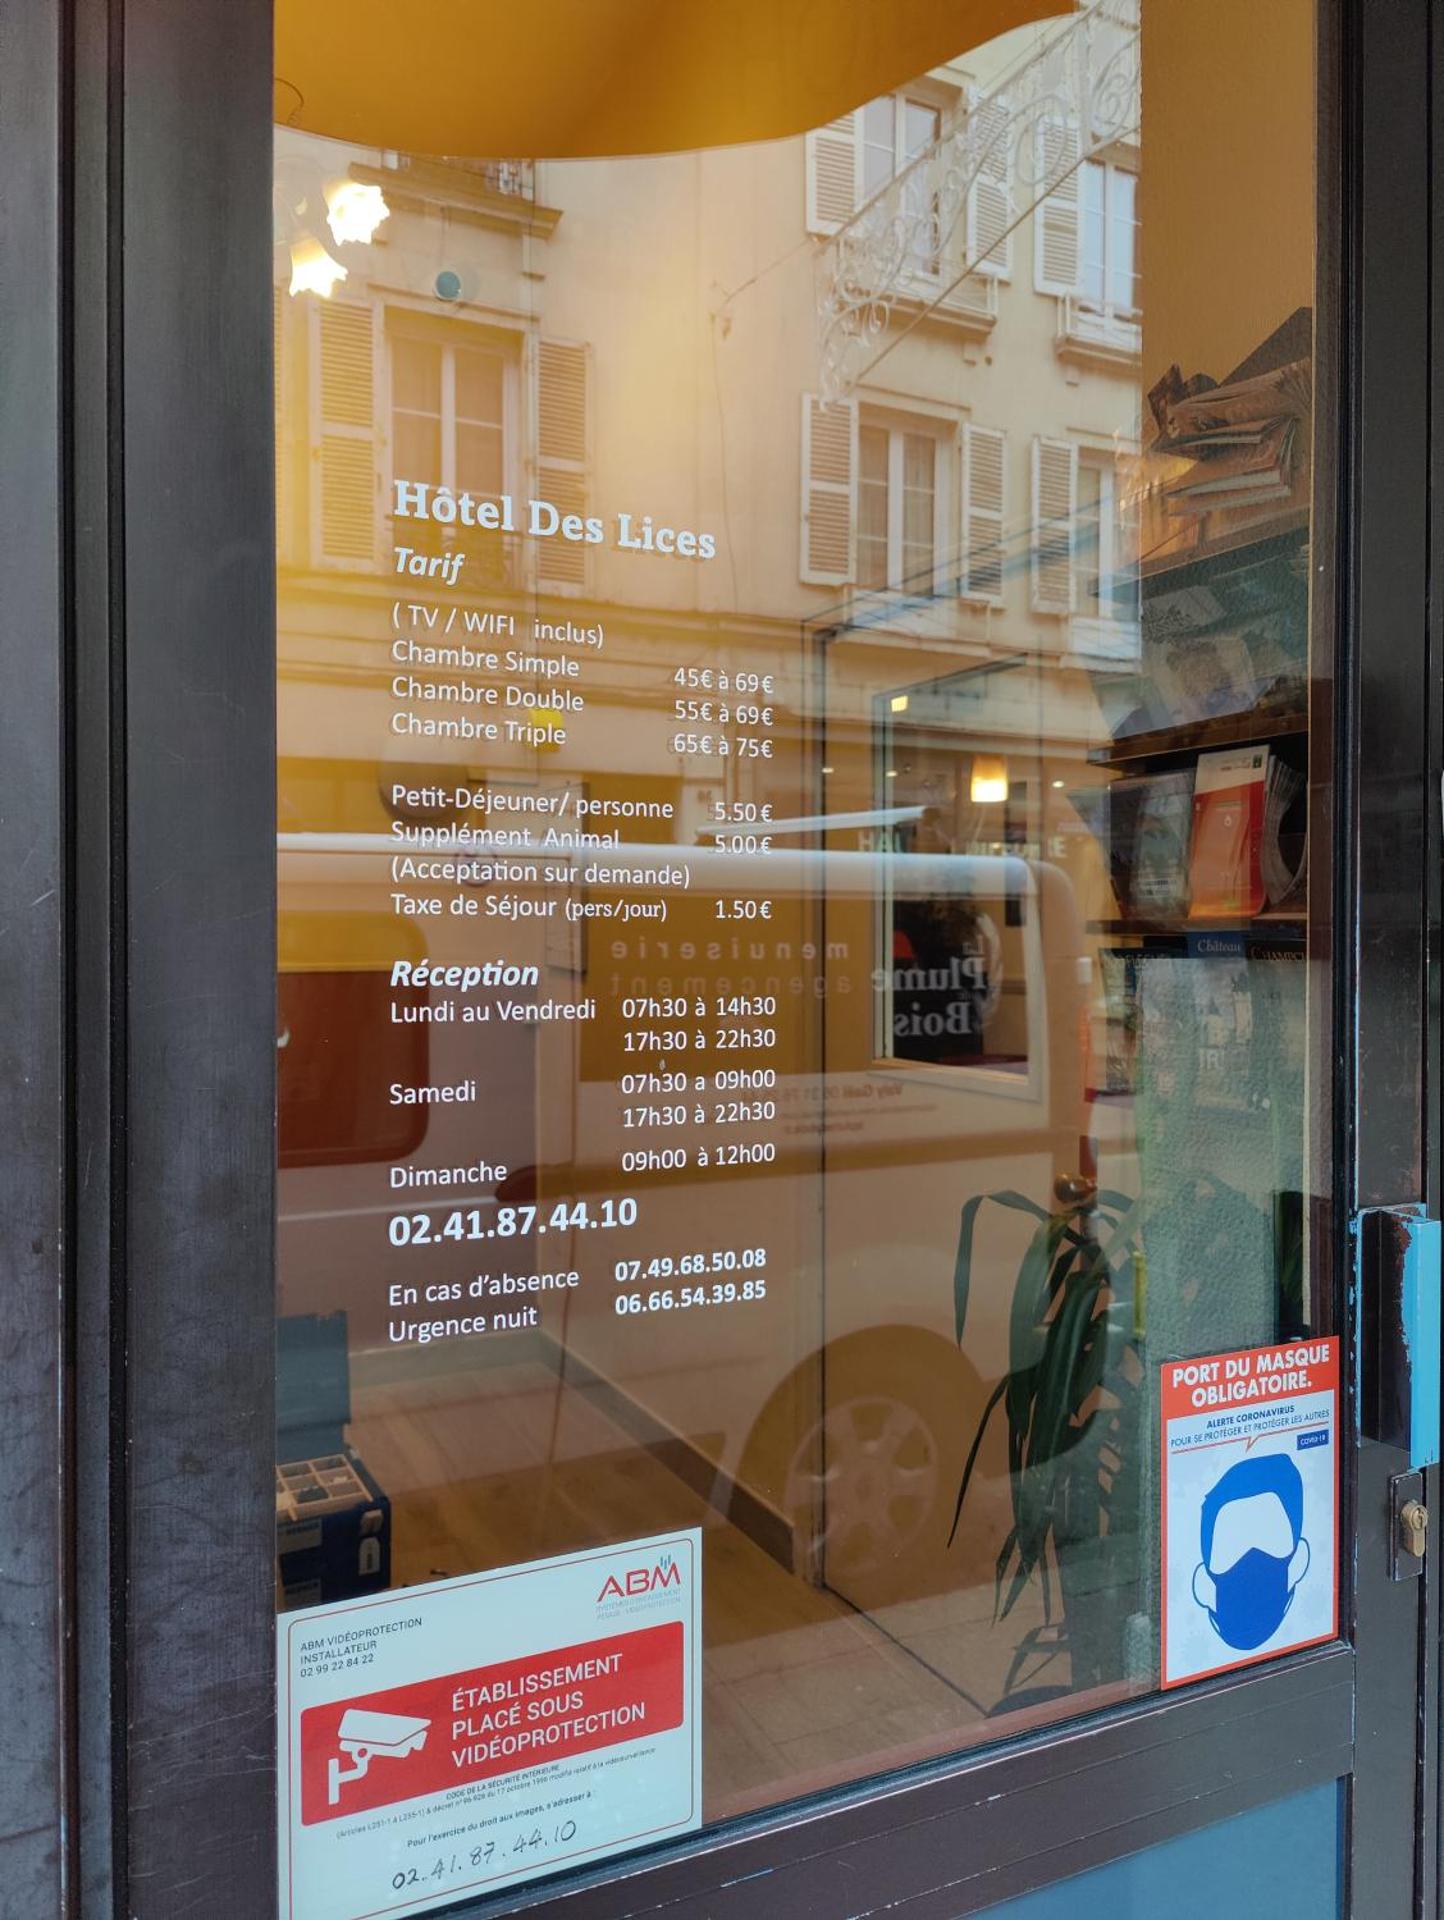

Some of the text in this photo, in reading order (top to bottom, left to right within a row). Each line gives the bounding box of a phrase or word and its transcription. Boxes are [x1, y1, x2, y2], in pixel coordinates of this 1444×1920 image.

[394, 479, 716, 559] Hôtel Des Lices
[394, 547, 464, 586] Tarif
[465, 612, 514, 636] WIFI
[535, 620, 604, 648] inclus)
[392, 639, 580, 678] Chambre Simple
[392, 676, 584, 712] Chambre Double
[674, 668, 774, 694] 45€ à 69€
[392, 713, 566, 748] Chambre Triple
[674, 700, 774, 726] 55€ à 69€
[673, 733, 773, 759] 65€ à 75€
[391, 785, 570, 816] Petit-Déjeuner/
[576, 796, 674, 818] personne
[391, 822, 530, 849] Supplément
[544, 827, 620, 850] Animal
[391, 857, 690, 889] (Acceptation sur demande)
[391, 893, 442, 915] Taxe
[450, 895, 477, 915] de
[486, 896, 556, 920] Séjour
[565, 897, 668, 922] (pers/jour)
[1197, 939, 1241, 953] Château
[390, 959, 538, 992] Réception
[391, 996, 776, 1023] Lundi au Vendredi 07h30 à 14h30
[623, 1029, 776, 1052] 17h30 à 22h30
[390, 1081, 476, 1106] Samedi
[621, 1072, 687, 1094] 07h30
[715, 1069, 775, 1089] 09h00
[623, 1106, 686, 1128] 17h30
[694, 1104, 705, 1124] à
[715, 1101, 775, 1124] 22h30
[390, 1144, 775, 1188] Dimanche 09h00 à 12h00
[389, 1197, 637, 1247] 02.41.87.44.10
[389, 1284, 417, 1306] En
[426, 1280, 461, 1301] cas
[615, 1249, 766, 1282] 07.49.68.50.08
[389, 1280, 766, 1343] Urgence nuit 06.66.54.39.85
[1173, 1346, 1330, 1388] PORT DU MASQUE
[1191, 1370, 1312, 1408] OBLIGATOIRE.
[1171, 1410, 1329, 1447] POUR SE PROTÉGER ET PROTÉGER LES AUTRES
[1206, 1406, 1295, 1429] ALERTE CORONAVIRUS
[596, 1561, 681, 1602] ABM
[301, 1618, 422, 1652] ABM VIDÉOPROTECTION
[301, 1640, 377, 1664] INSTALLATEUR
[301, 1653, 374, 1677] 02 99 22 84 22
[451, 1654, 623, 1712] ÉTABLISSEMENT
[451, 1692, 584, 1740] PLACÉ SOUS
[451, 1702, 646, 1768] VIDÉOPROTECTION
[446, 1789, 466, 1800] CODE
[477, 1784, 486, 1792] LA
[507, 1781, 531, 1793] octobre
[407, 1833, 426, 1847] Pour
[428, 1823, 465, 1841] l'exercice
[468, 1820, 478, 1831] du
[480, 1812, 498, 1828] droit
[499, 1811, 513, 1822] aux
[515, 1804, 546, 1819] images,
